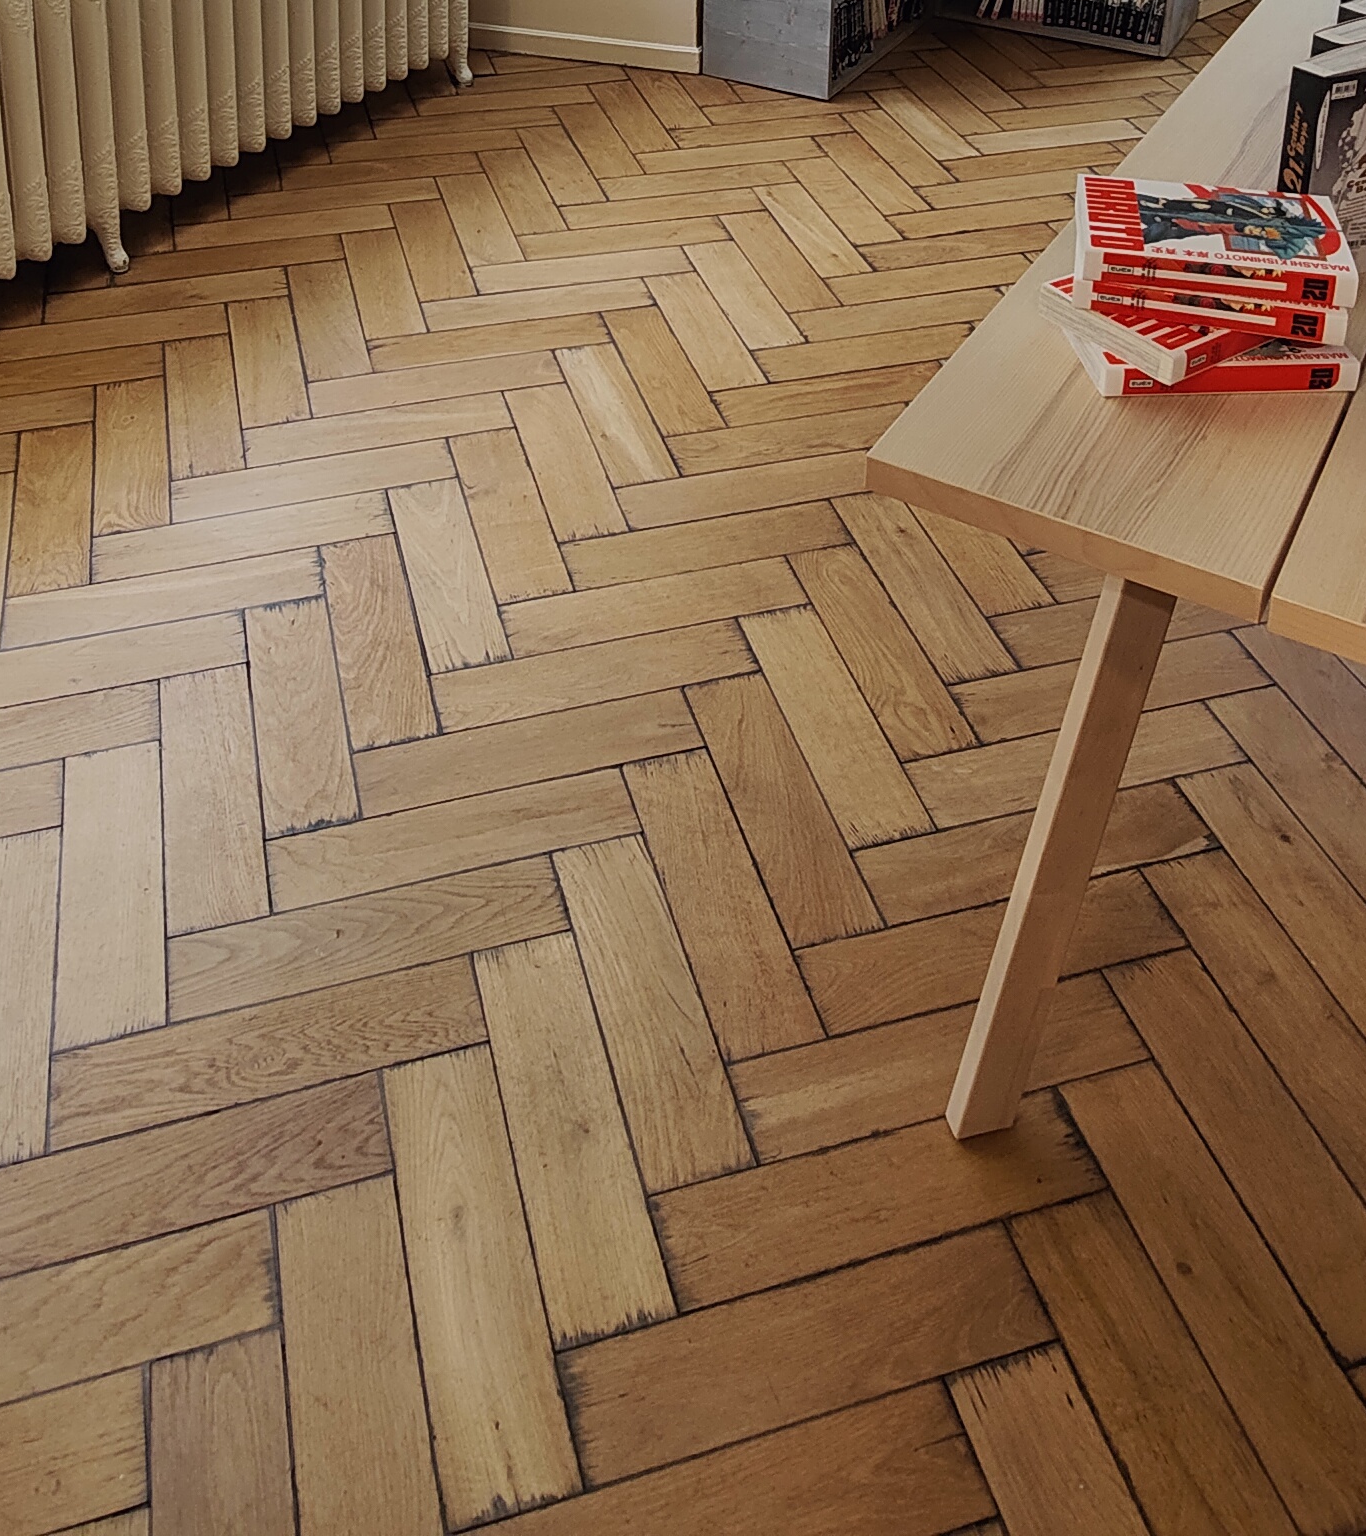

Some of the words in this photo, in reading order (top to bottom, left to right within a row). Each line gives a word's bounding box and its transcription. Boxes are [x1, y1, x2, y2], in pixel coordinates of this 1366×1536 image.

[1287, 101, 1303, 156] Century
[1296, 122, 1308, 155] Boys
[1283, 158, 1303, 193] 21
[1084, 177, 1145, 252] NARUTO
[1295, 259, 1350, 273] MASASHI
[1301, 278, 1329, 301] 02
[1290, 314, 1318, 337] 02
